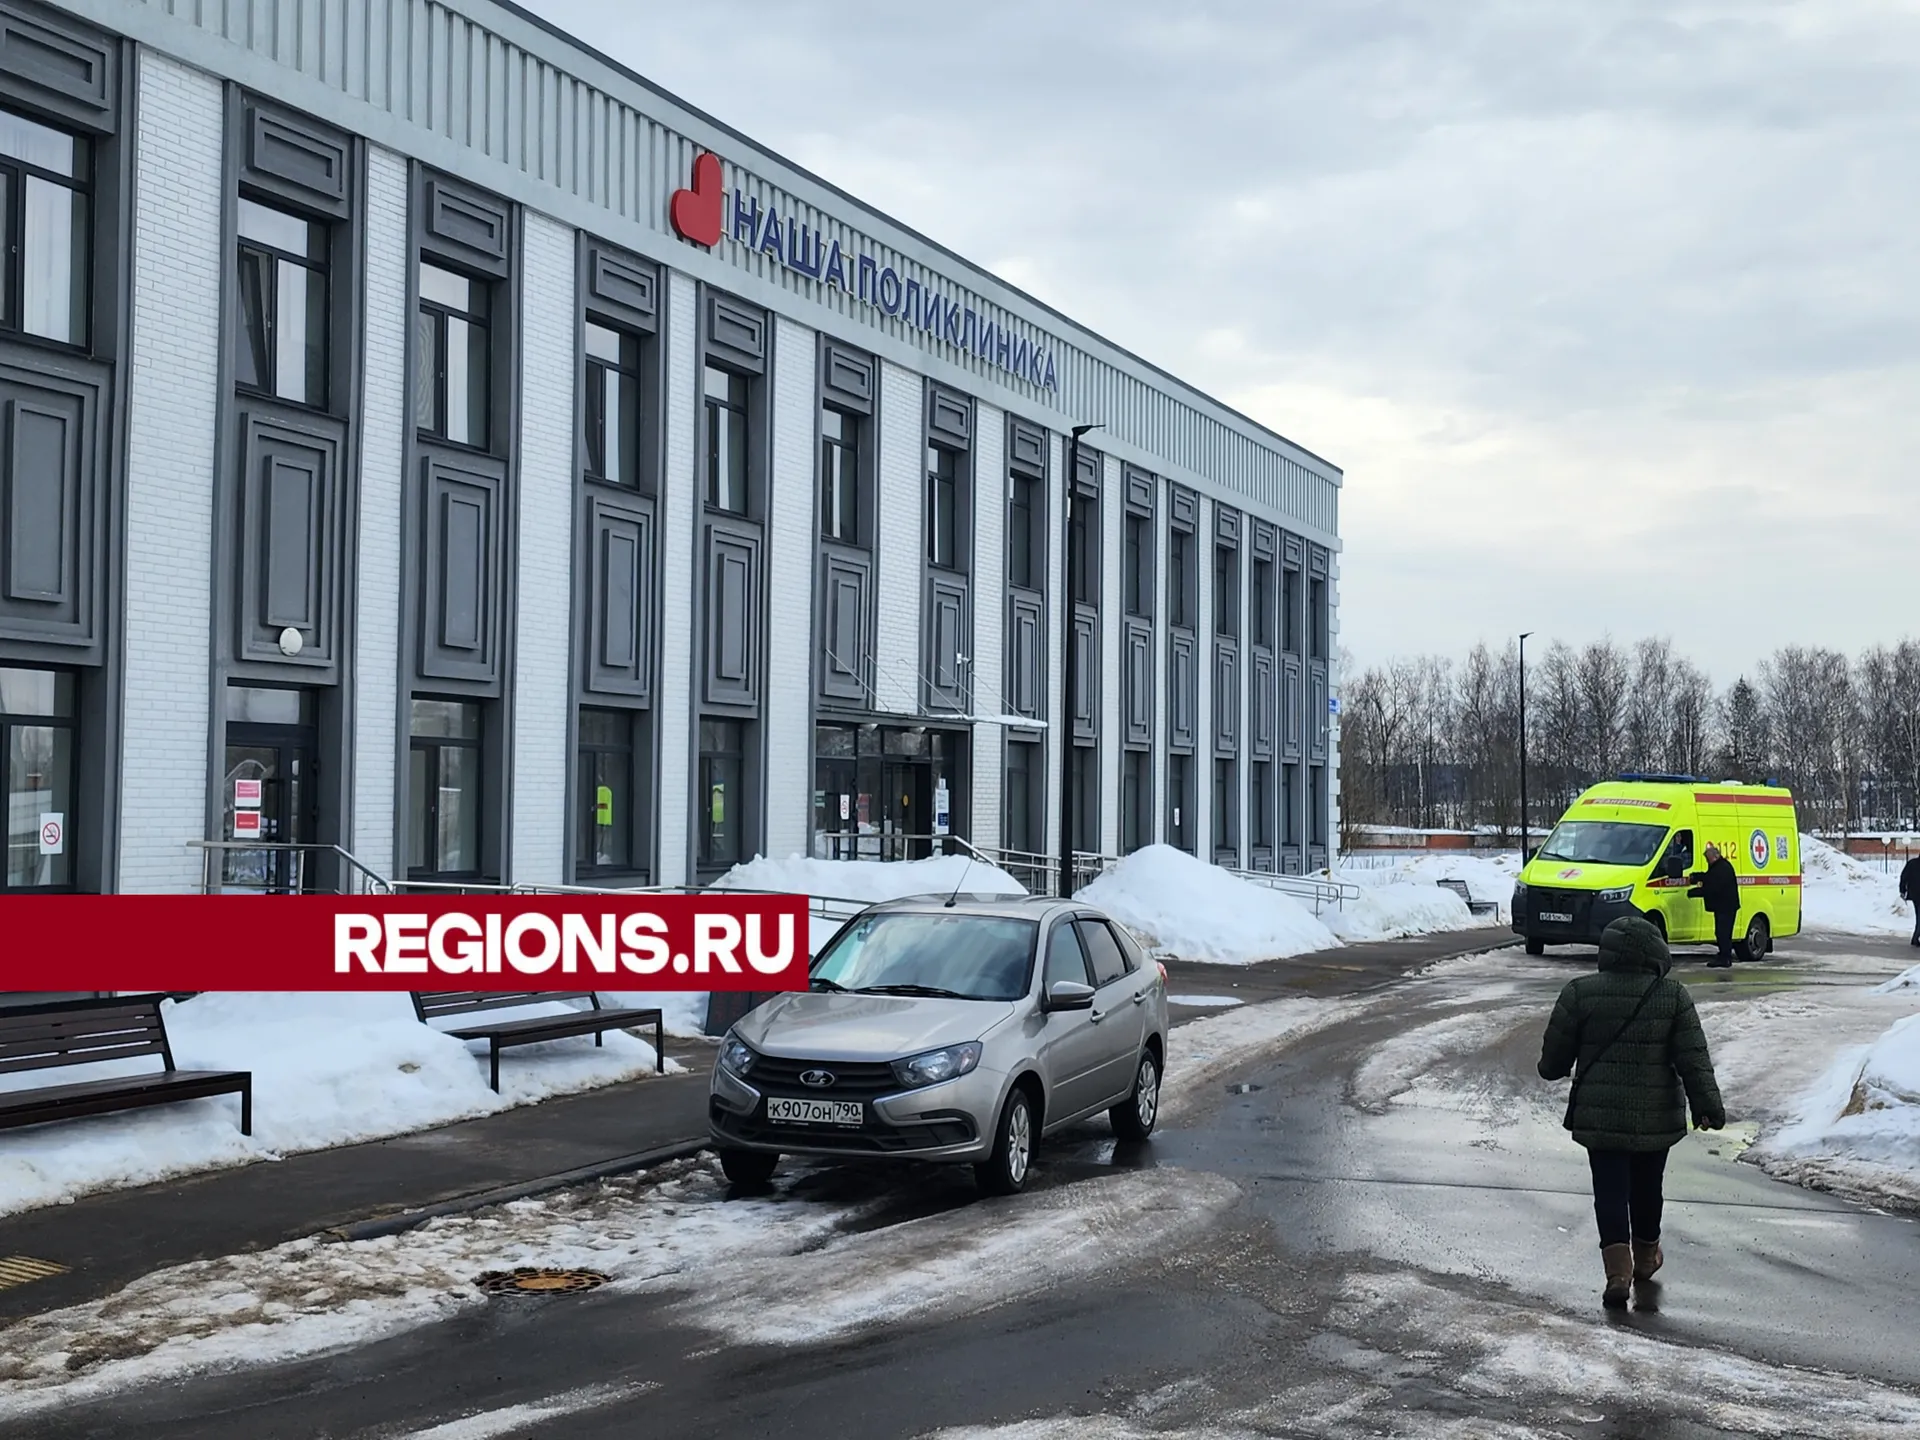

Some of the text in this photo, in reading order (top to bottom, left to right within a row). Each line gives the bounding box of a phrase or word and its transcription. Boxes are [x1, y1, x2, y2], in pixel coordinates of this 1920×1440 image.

[731, 187, 1057, 393] НАША ПОЛИКЛИНИКА
[1717, 841, 1738, 860] 112
